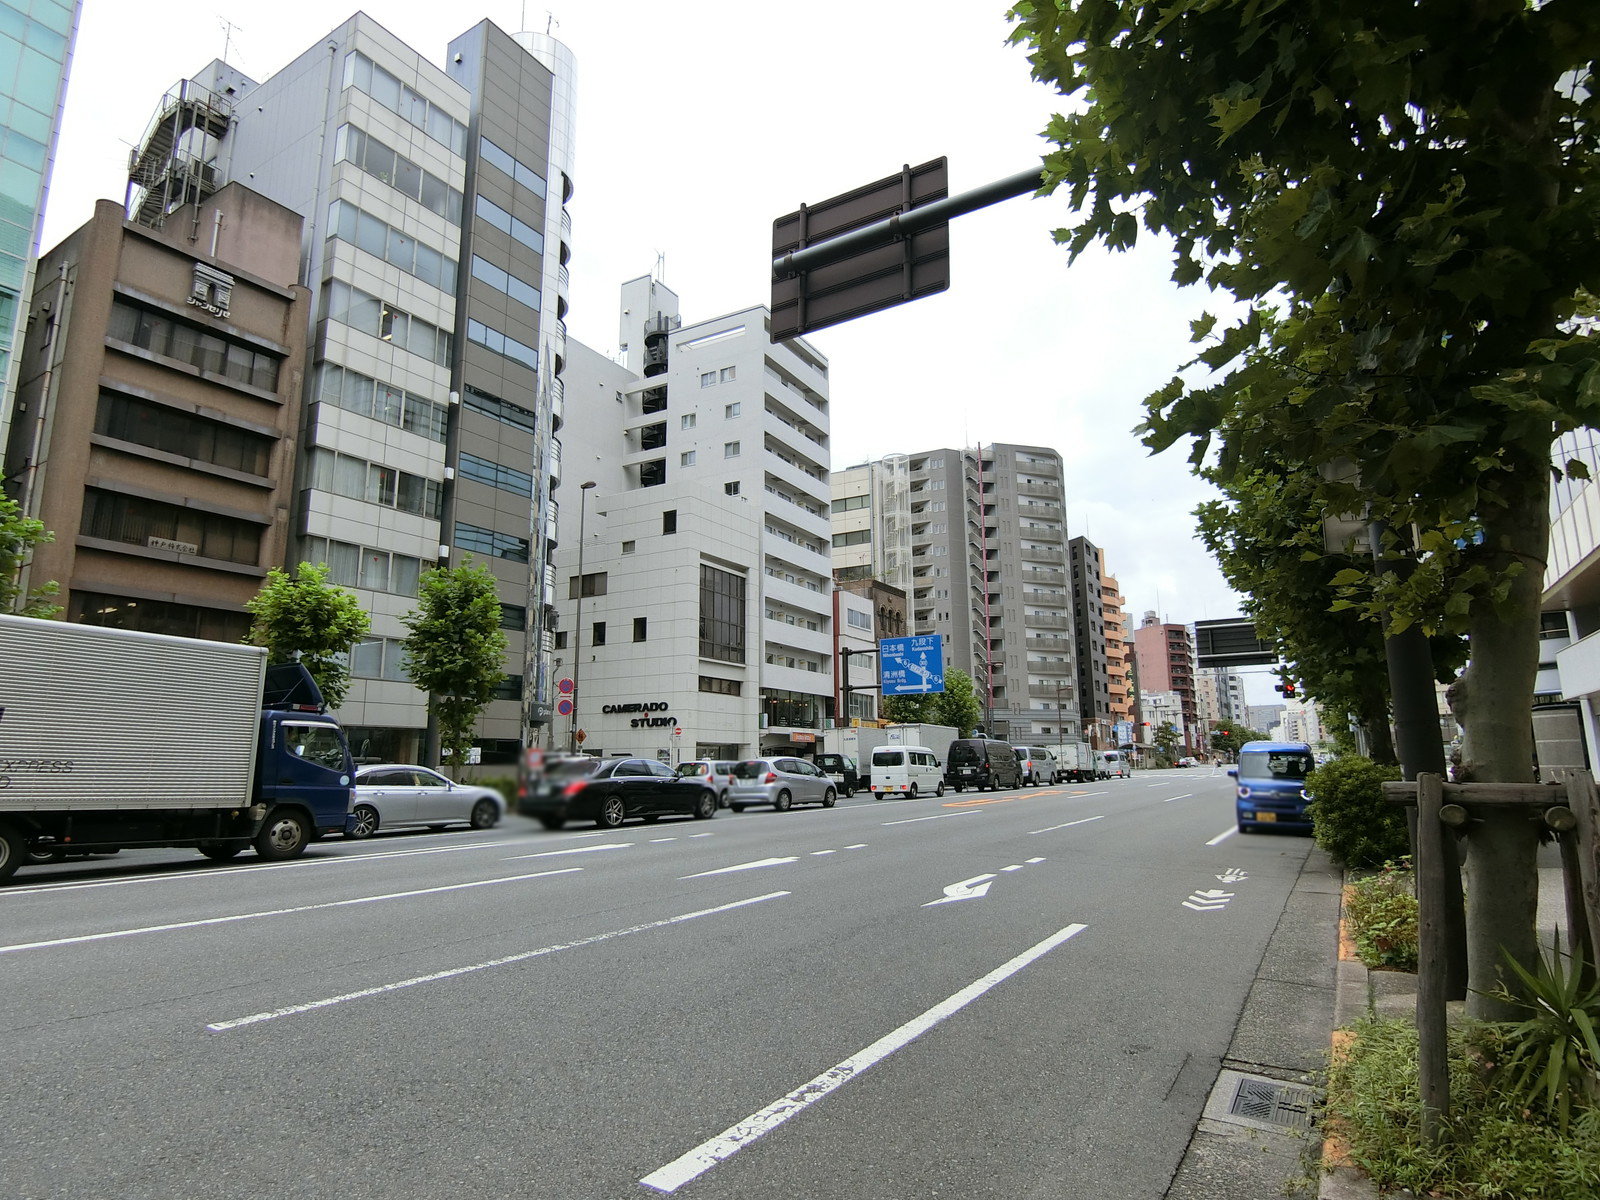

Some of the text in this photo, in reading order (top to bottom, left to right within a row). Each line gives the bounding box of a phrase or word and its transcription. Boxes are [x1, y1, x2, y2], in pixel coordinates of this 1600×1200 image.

[911, 637, 934, 647] 九段下
[882, 643, 905, 653] 日本橋
[602, 702, 669, 714] CAMERADO
[631, 717, 678, 728] STUDIO
